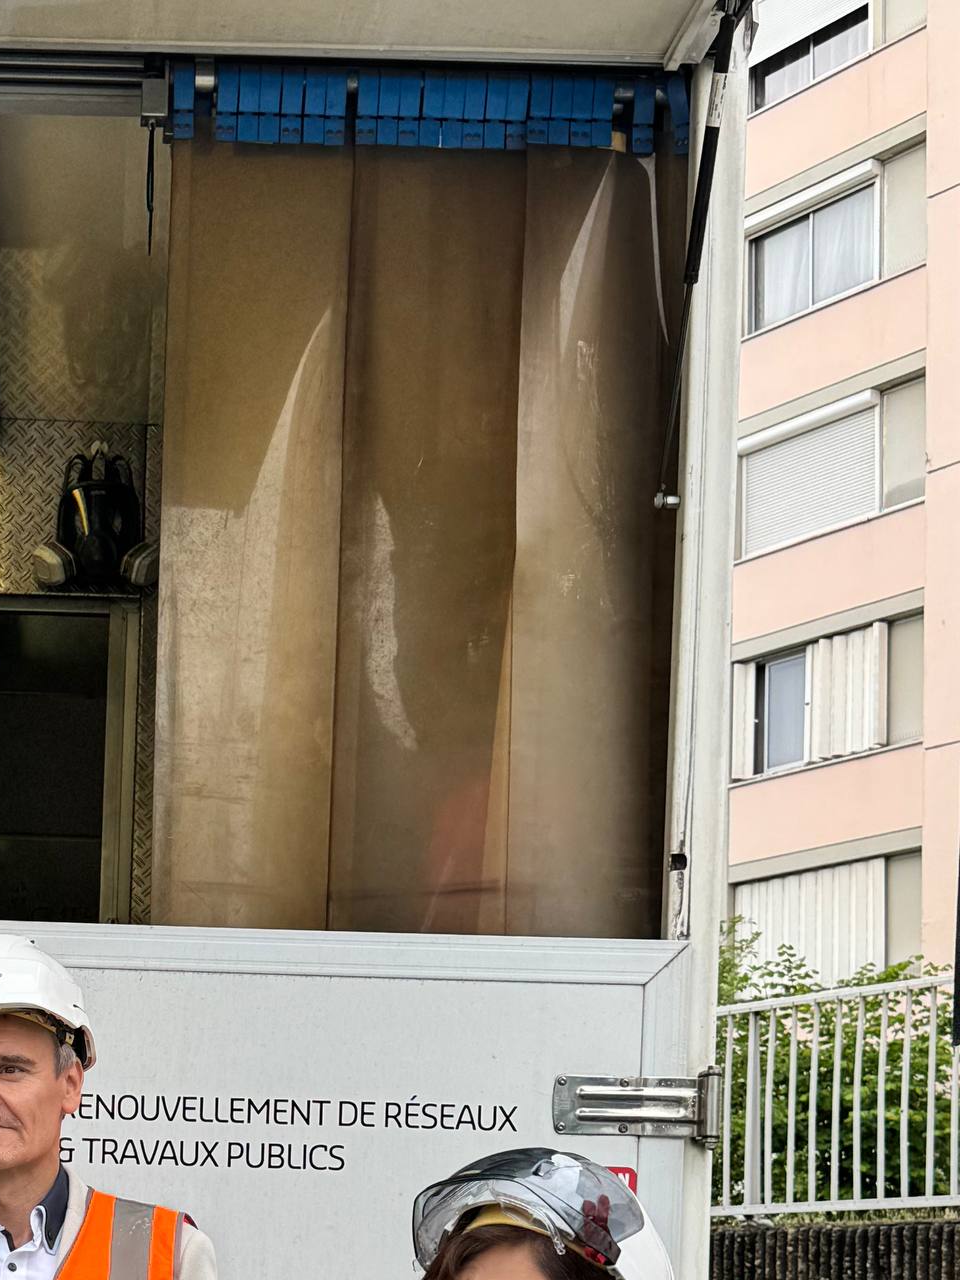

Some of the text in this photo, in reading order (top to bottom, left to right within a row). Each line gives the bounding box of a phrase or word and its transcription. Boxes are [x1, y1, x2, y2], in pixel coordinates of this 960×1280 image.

[65, 1093, 518, 1132] ENOUVELLEMENT DE RÉSEAUX
[59, 1136, 345, 1171] & TRAVAUX PUBLICS
